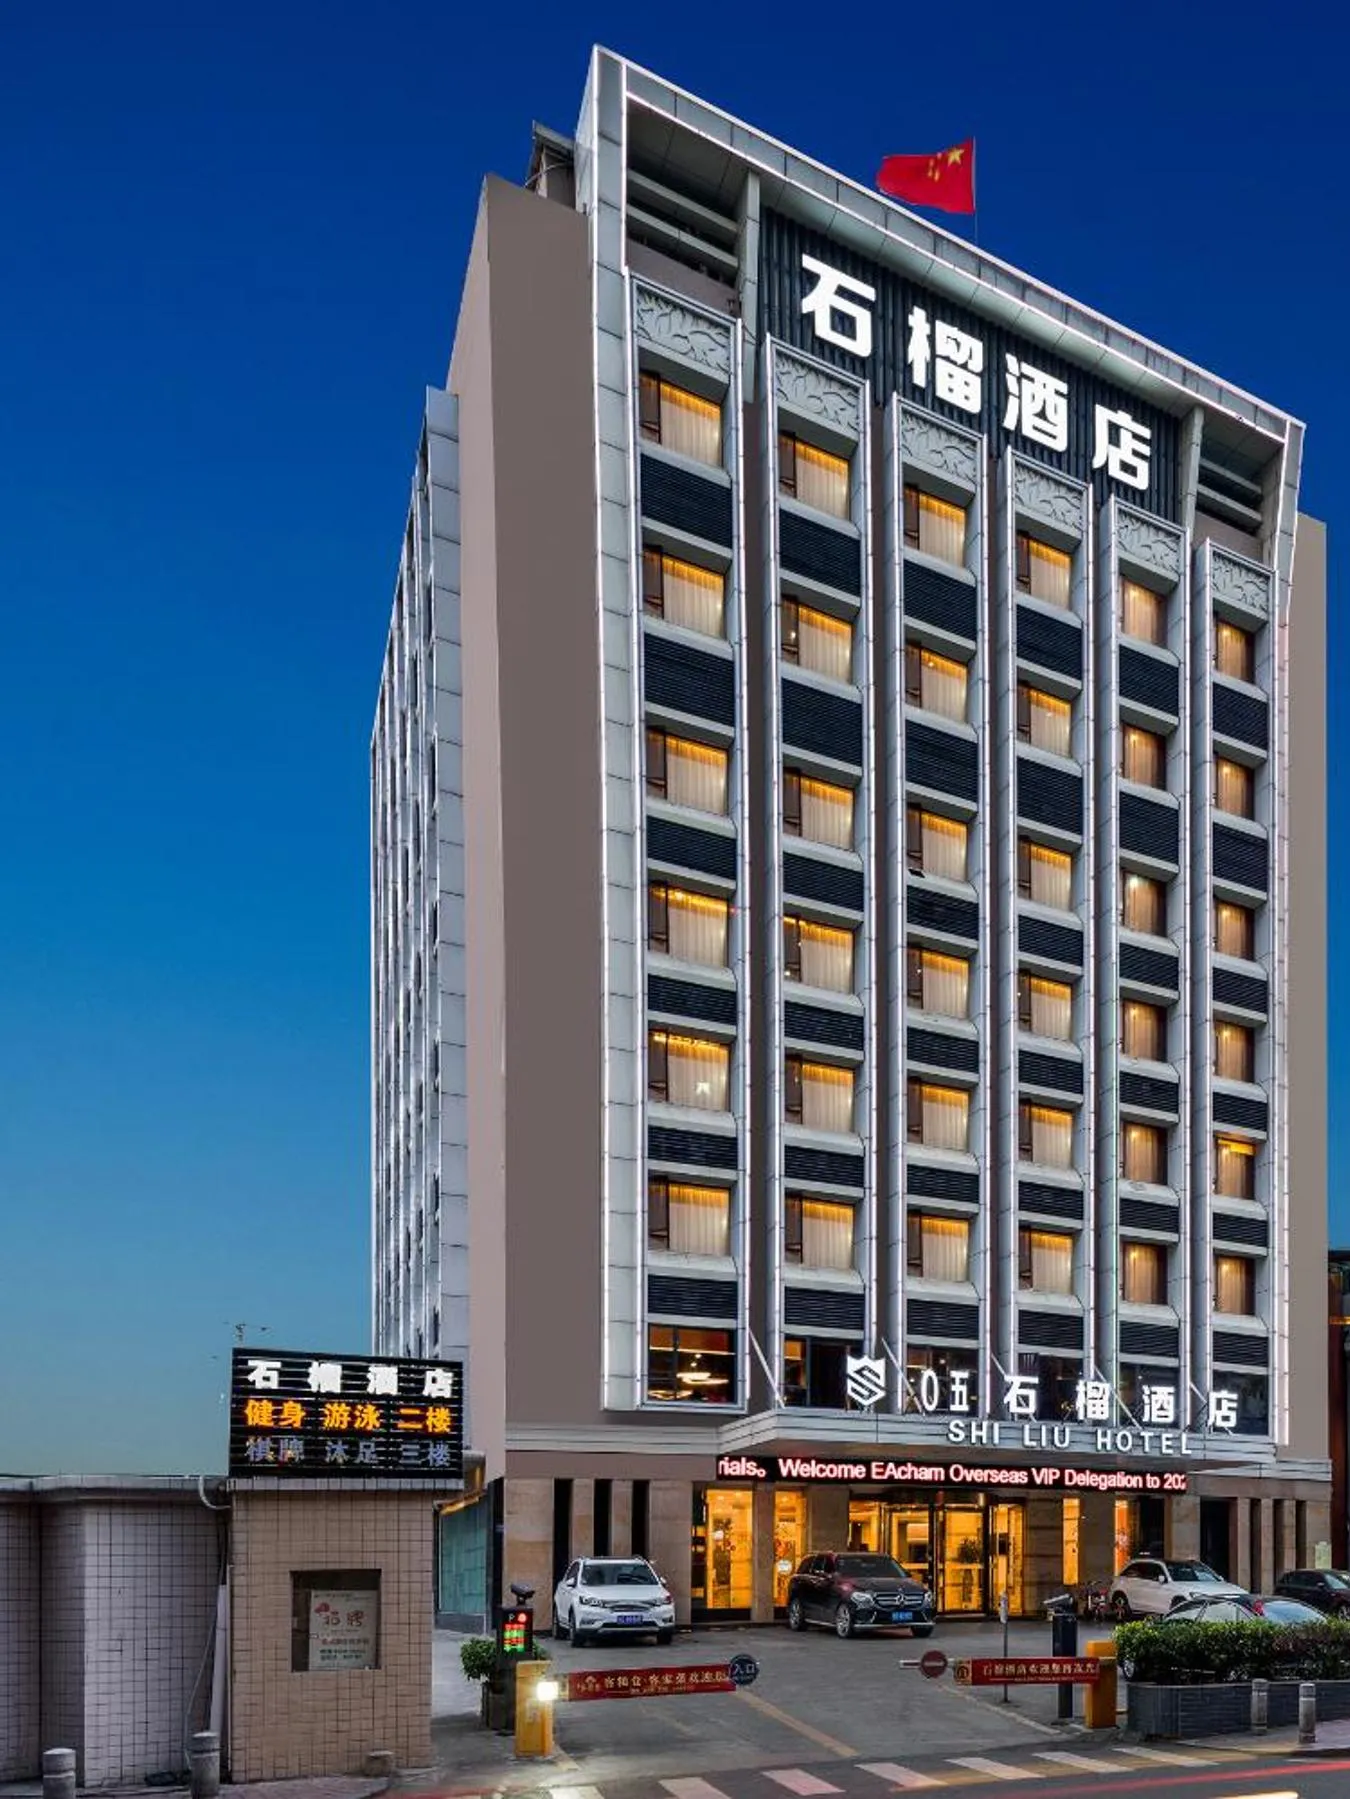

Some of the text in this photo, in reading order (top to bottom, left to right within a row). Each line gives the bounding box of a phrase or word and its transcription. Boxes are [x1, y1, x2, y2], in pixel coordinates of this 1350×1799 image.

[801, 253, 1152, 491] 石榴酒店
[247, 1359, 454, 1399] 石榴酒店
[244, 1399, 450, 1434] 健身 游泳 二楼
[1003, 1373, 1239, 1428] 石榴酒店
[947, 1418, 1192, 1455] SHI LIU HOTEL
[778, 1458, 867, 1479] Welcome
[871, 1461, 945, 1482] EAcham
[949, 1463, 1029, 1485] Overseas
[1031, 1468, 1060, 1485] VIP
[1064, 1468, 1144, 1491] Delegation
[1146, 1472, 1161, 1489] to
[733, 1663, 755, 1674] 入口
